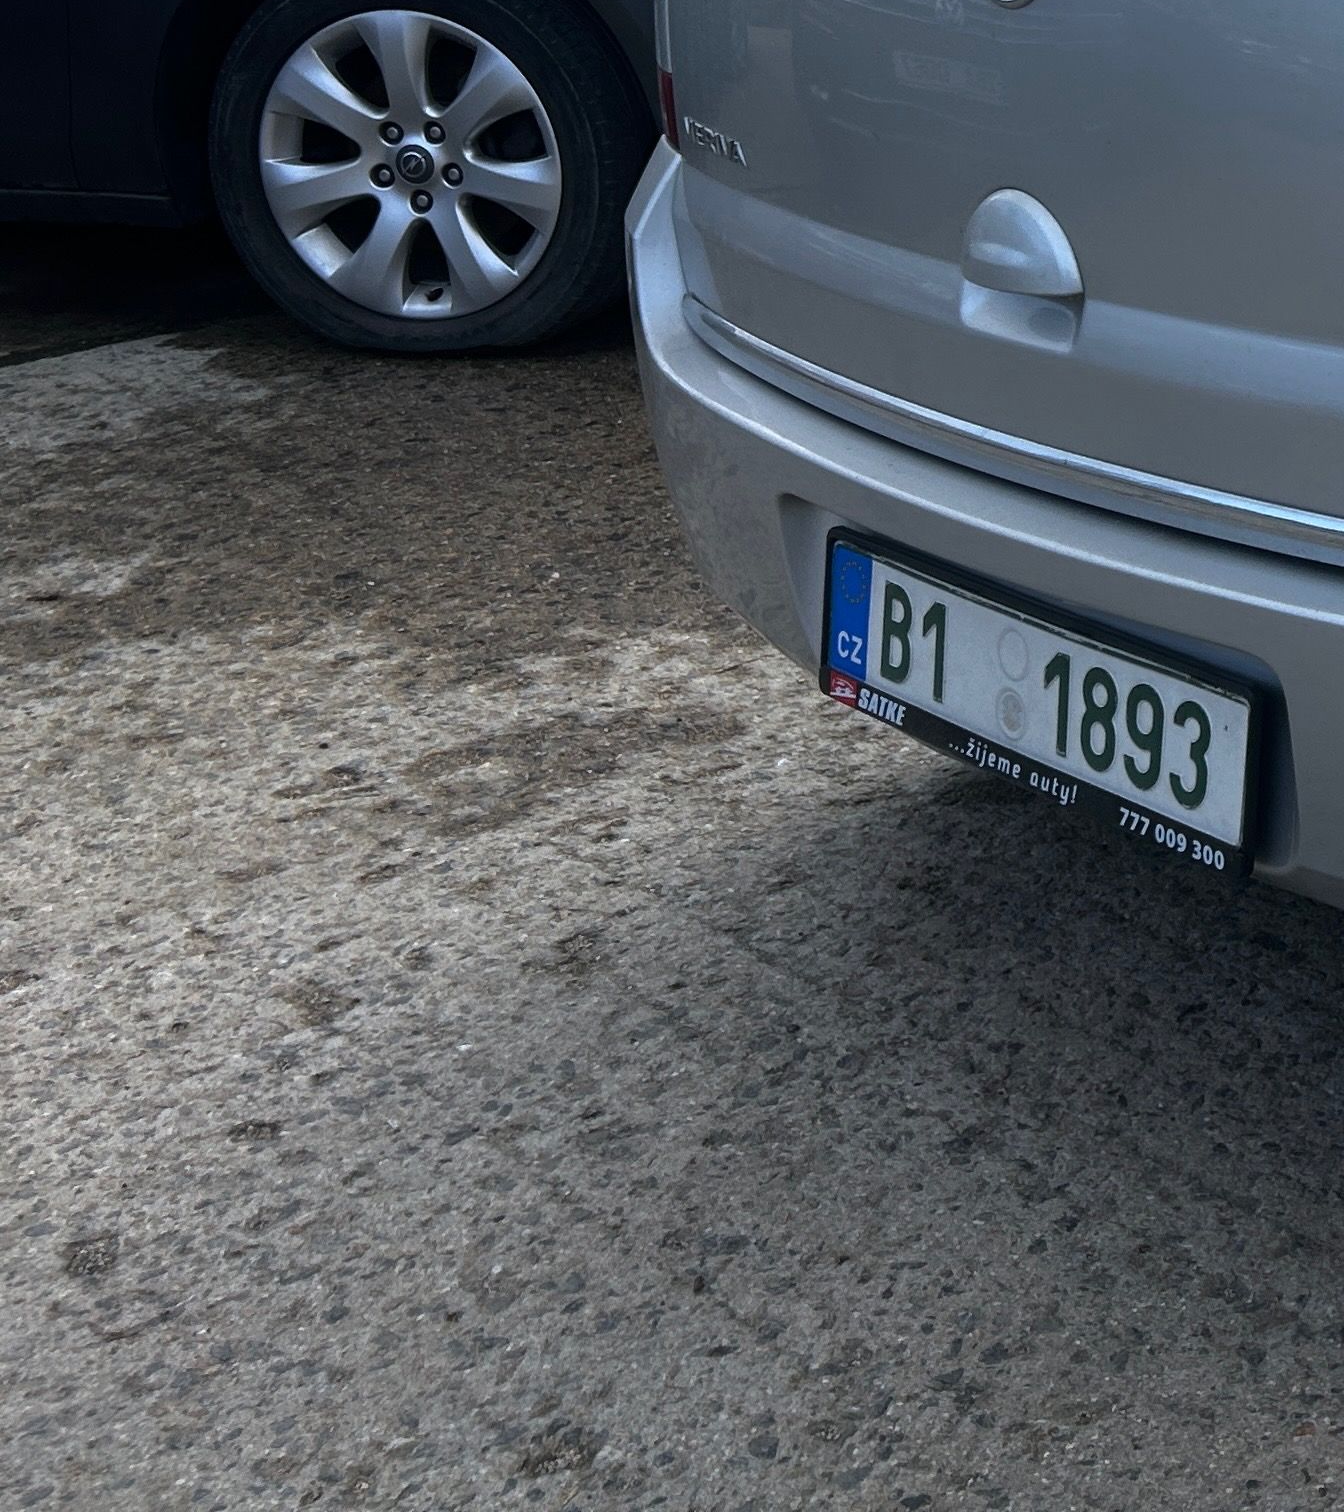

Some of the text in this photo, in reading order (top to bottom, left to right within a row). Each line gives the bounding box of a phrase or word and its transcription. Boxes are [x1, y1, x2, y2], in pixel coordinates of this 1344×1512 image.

[837, 630, 863, 665] CZ
[857, 688, 906, 727] SATKE
[880, 580, 1212, 810] B1 1893
[1029, 774, 1078, 806] auty!
[1117, 806, 1226, 871] 777 009 300
